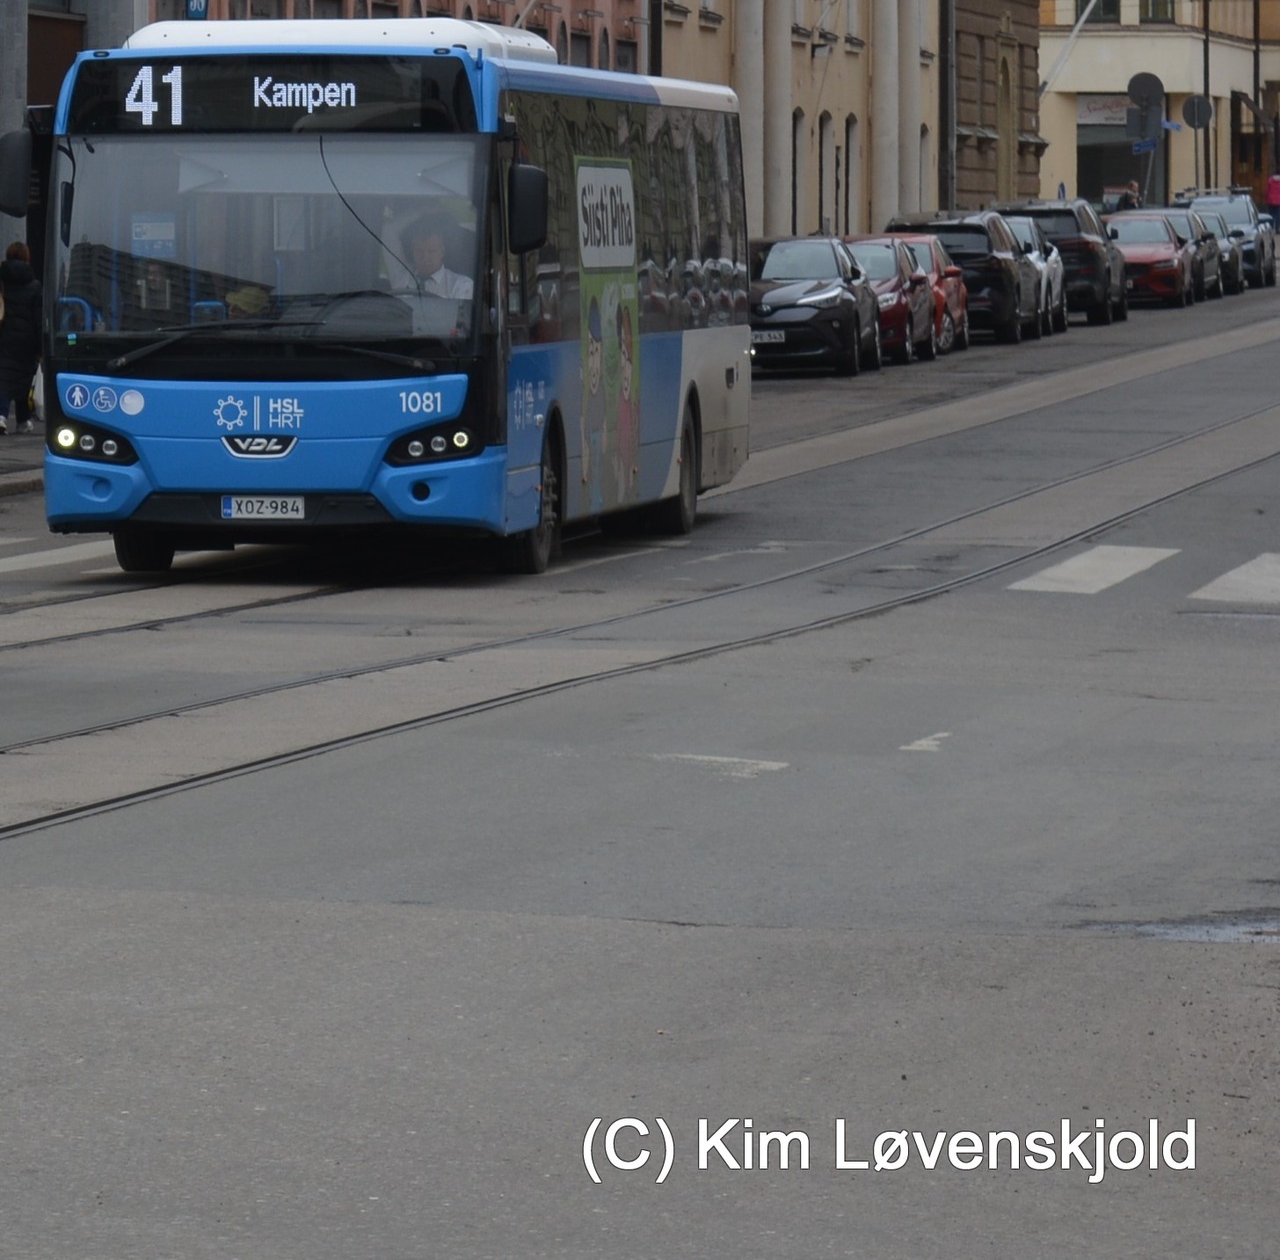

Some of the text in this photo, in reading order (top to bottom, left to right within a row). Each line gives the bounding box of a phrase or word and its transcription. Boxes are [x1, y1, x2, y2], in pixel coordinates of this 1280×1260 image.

[125, 66, 356, 125] 41 Kampen
[581, 184, 633, 247] Siisti Piha
[269, 398, 304, 413] HSL
[400, 392, 441, 413] 1081
[269, 413, 304, 428] HRT
[233, 438, 283, 451] VDL
[235, 500, 300, 514] XOZ-984
